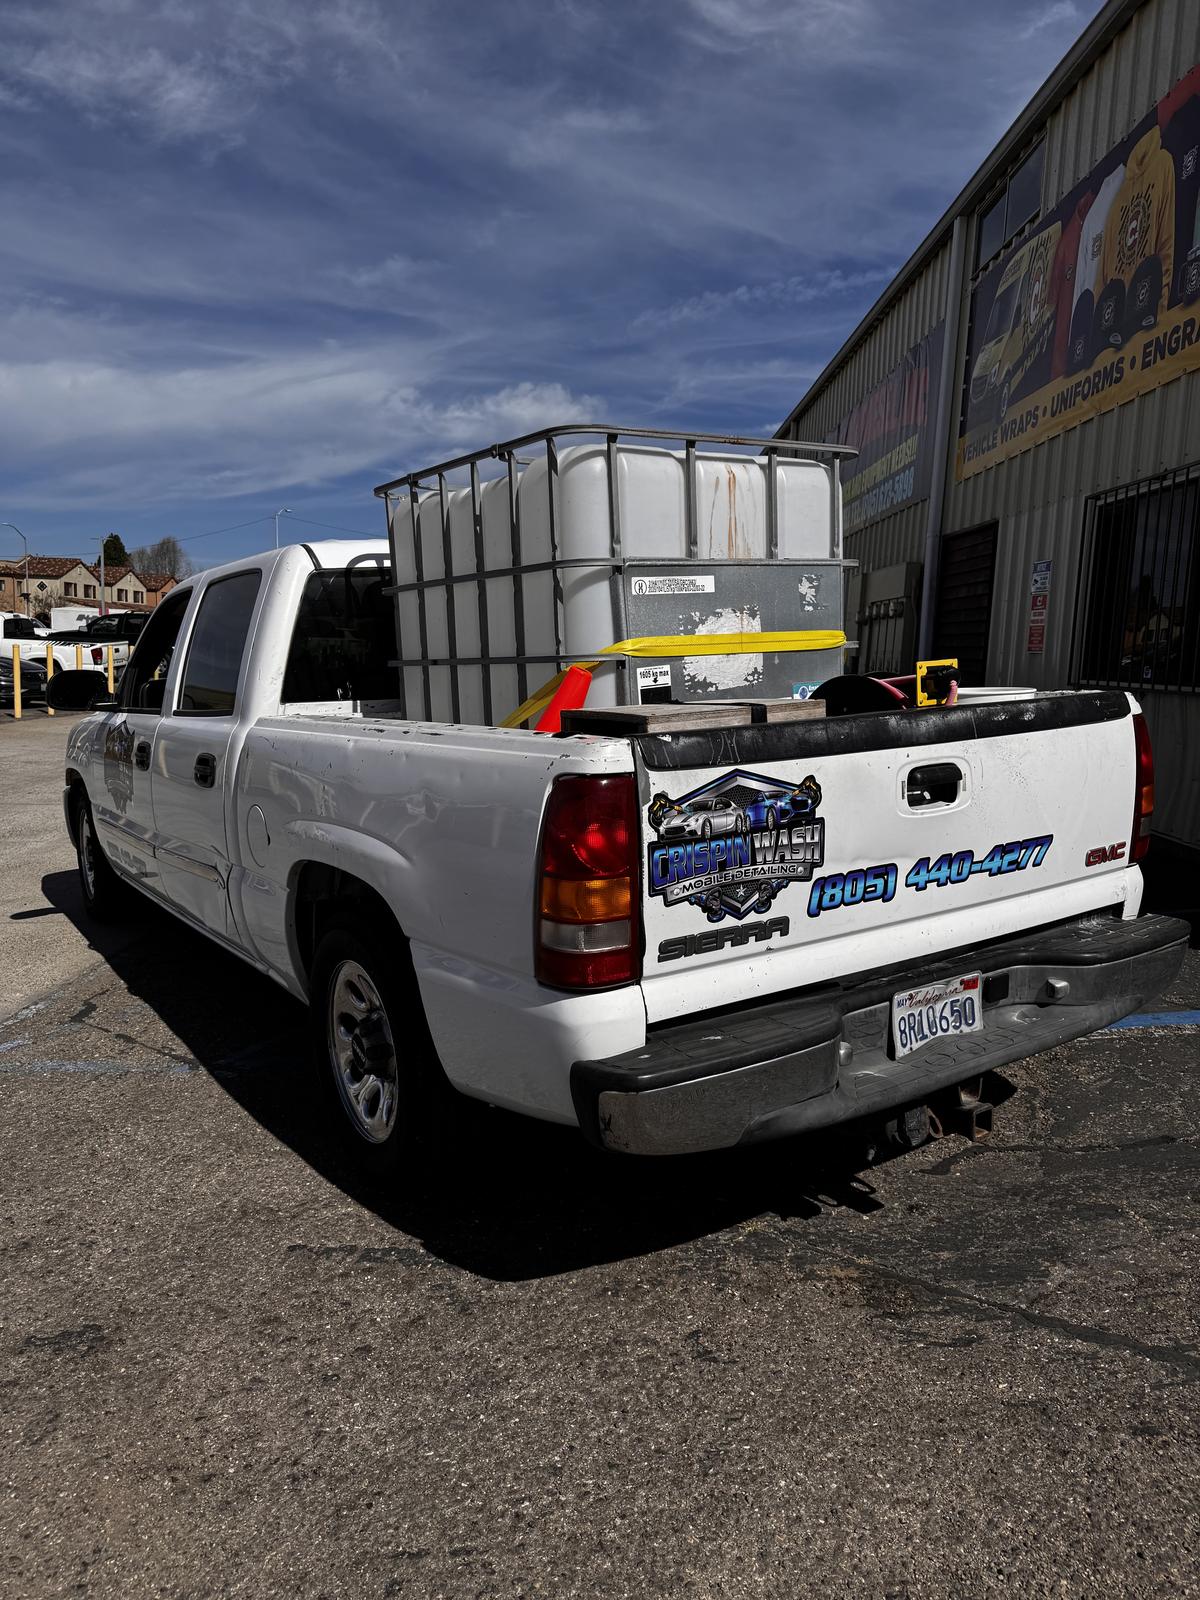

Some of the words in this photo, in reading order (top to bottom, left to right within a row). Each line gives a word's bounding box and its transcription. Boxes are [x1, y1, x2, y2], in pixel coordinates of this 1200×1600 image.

[962, 429, 999, 465] VEHICLE
[999, 405, 1040, 444] WRAPS
[1051, 356, 1125, 418] UNIFORMS
[652, 835, 750, 889] CRISPIN
[753, 824, 822, 864] WASH
[682, 872, 732, 894] MOBILE
[735, 864, 797, 880] DETAILING
[807, 863, 898, 918] (805)
[905, 834, 1054, 891] 440-4277
[1085, 841, 1127, 867] GMC
[658, 916, 790, 963] SIERRA
[897, 998, 908, 1008] MAY
[908, 985, 964, 1008] California
[898, 996, 976, 1049] 8R10650
